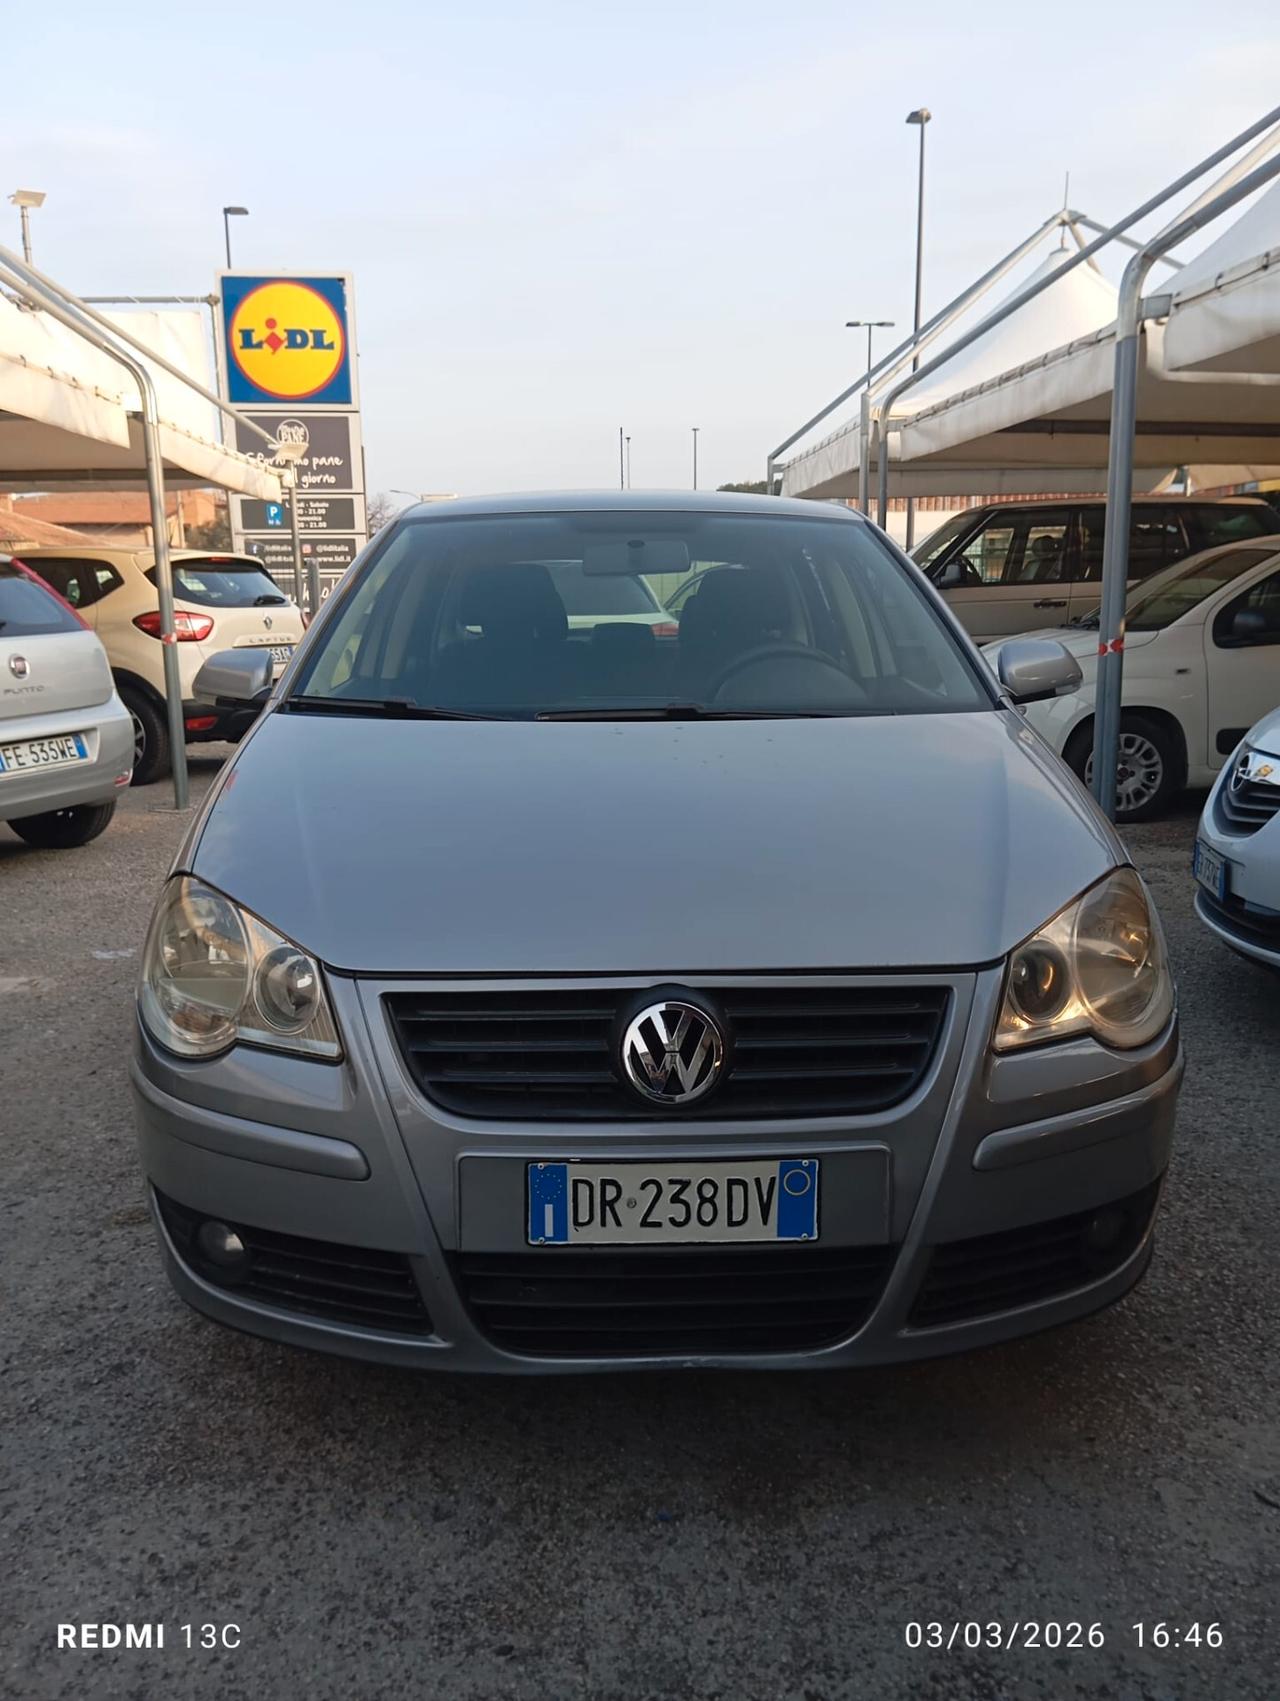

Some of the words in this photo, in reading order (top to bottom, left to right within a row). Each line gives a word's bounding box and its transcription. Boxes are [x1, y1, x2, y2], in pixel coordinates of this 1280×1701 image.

[312, 456, 344, 470] pane
[301, 472, 337, 488] giorno
[269, 506, 278, 517] P
[2, 746, 26, 768] FE
[28, 738, 77, 763] 535WE
[571, 1177, 623, 1228] DR
[639, 1176, 776, 1228] 238DV
